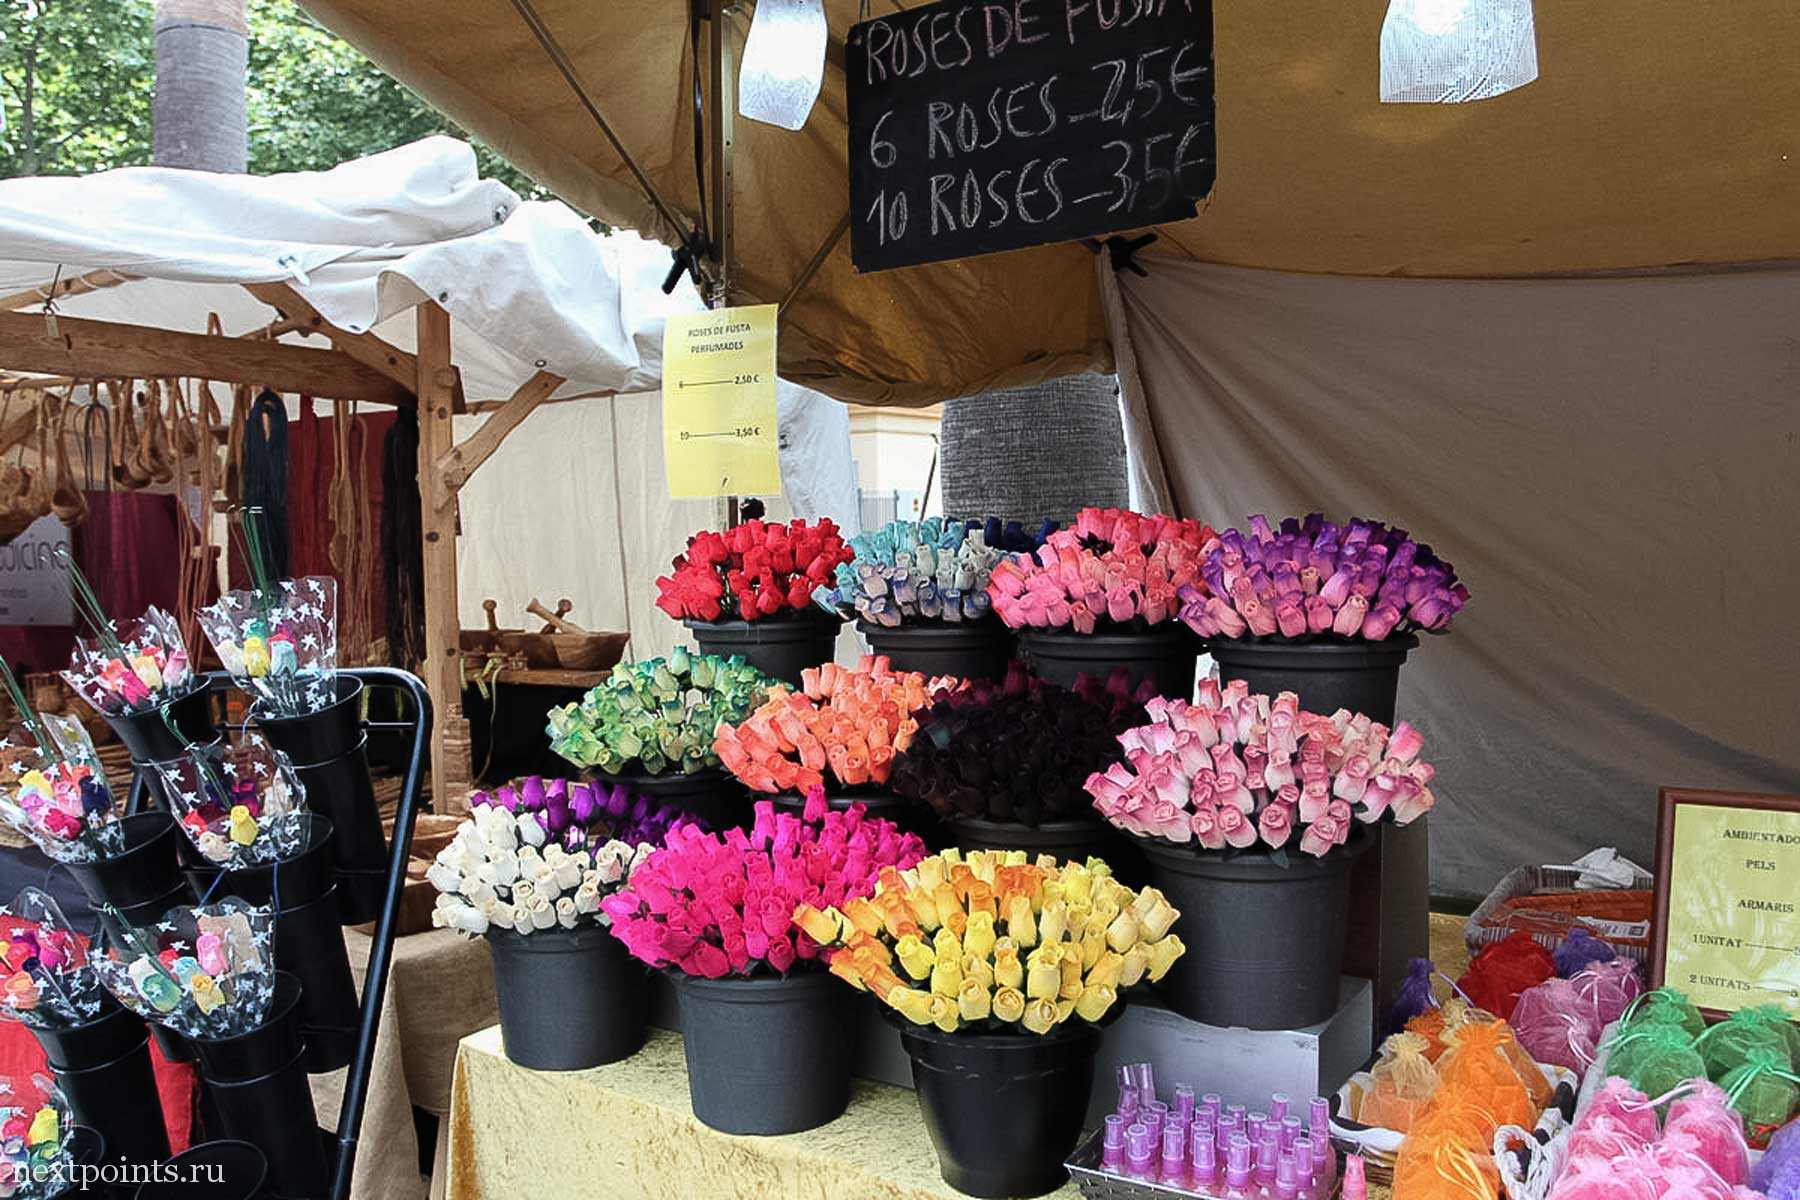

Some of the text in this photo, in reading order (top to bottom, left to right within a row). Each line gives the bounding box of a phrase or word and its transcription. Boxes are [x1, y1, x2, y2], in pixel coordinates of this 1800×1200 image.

[867, 7, 973, 84] ROSES
[984, 0, 1049, 58] DE
[871, 110, 897, 168] 6
[928, 74, 1059, 159] ROSES
[867, 189, 908, 247] 10
[930, 157, 1069, 236] ROSES
[725, 323, 751, 333] FUSTA
[690, 341, 744, 353] PERFUMADES
[1745, 859, 1776, 871] PELS
[1738, 899, 1794, 914] ARMARIS
[1699, 934, 1743, 949] UNITAT
[1689, 974, 1697, 983] 2
[1700, 975, 1751, 991] UNITATS
